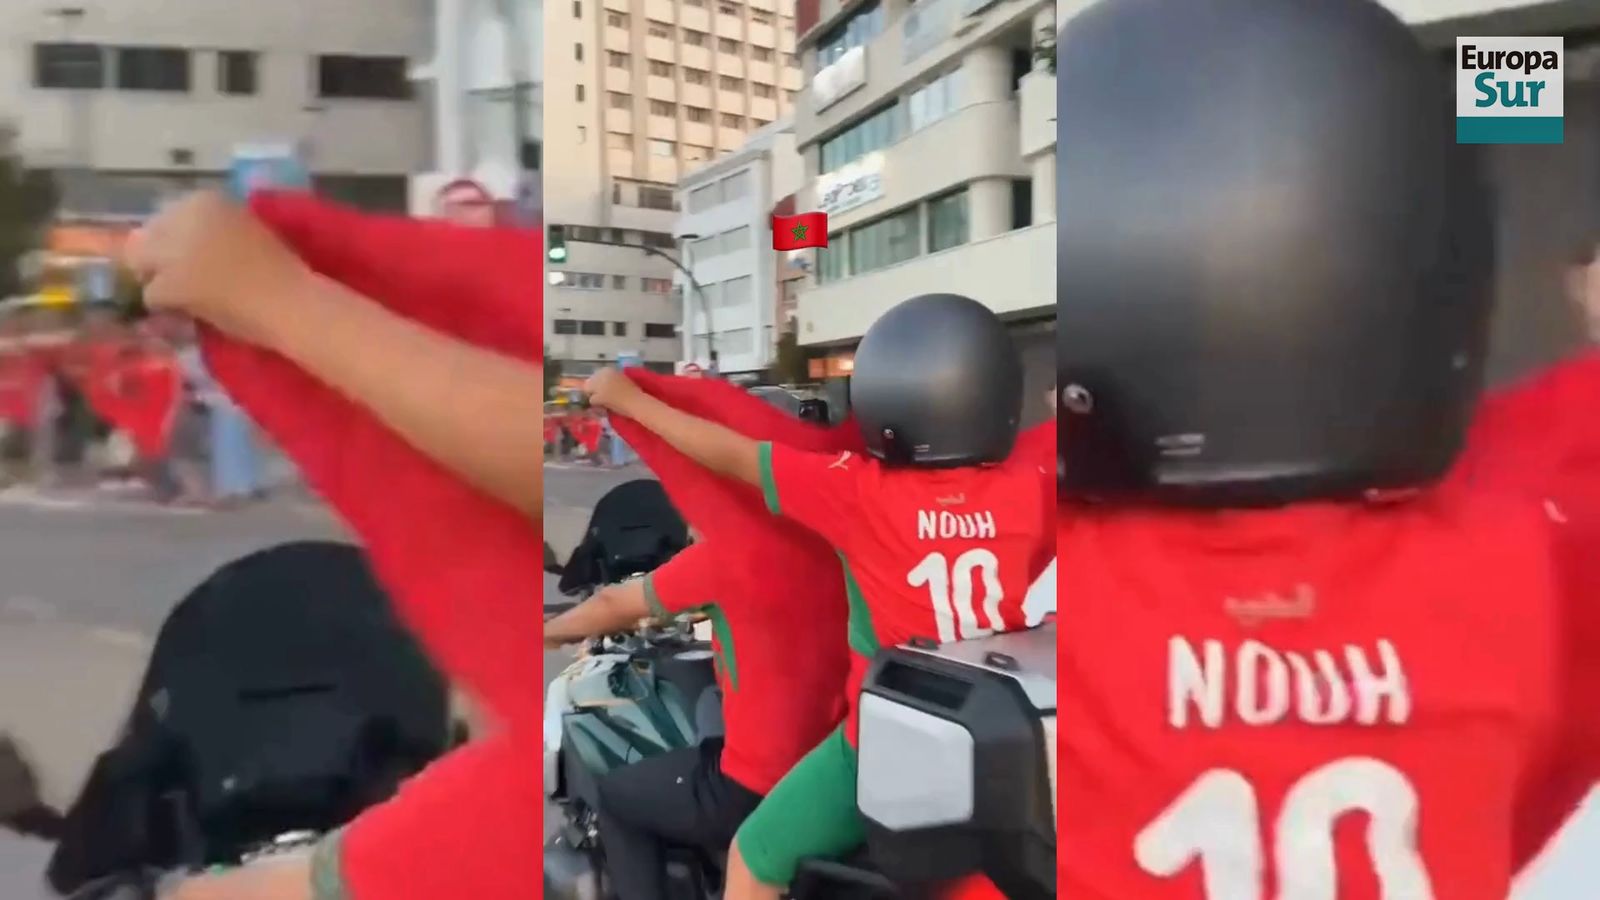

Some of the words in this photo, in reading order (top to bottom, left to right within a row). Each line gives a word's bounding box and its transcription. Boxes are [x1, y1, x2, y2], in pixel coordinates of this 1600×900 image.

[918, 509, 996, 540] NOUH
[907, 548, 1006, 643] 10
[1168, 634, 1412, 729] NOUH
